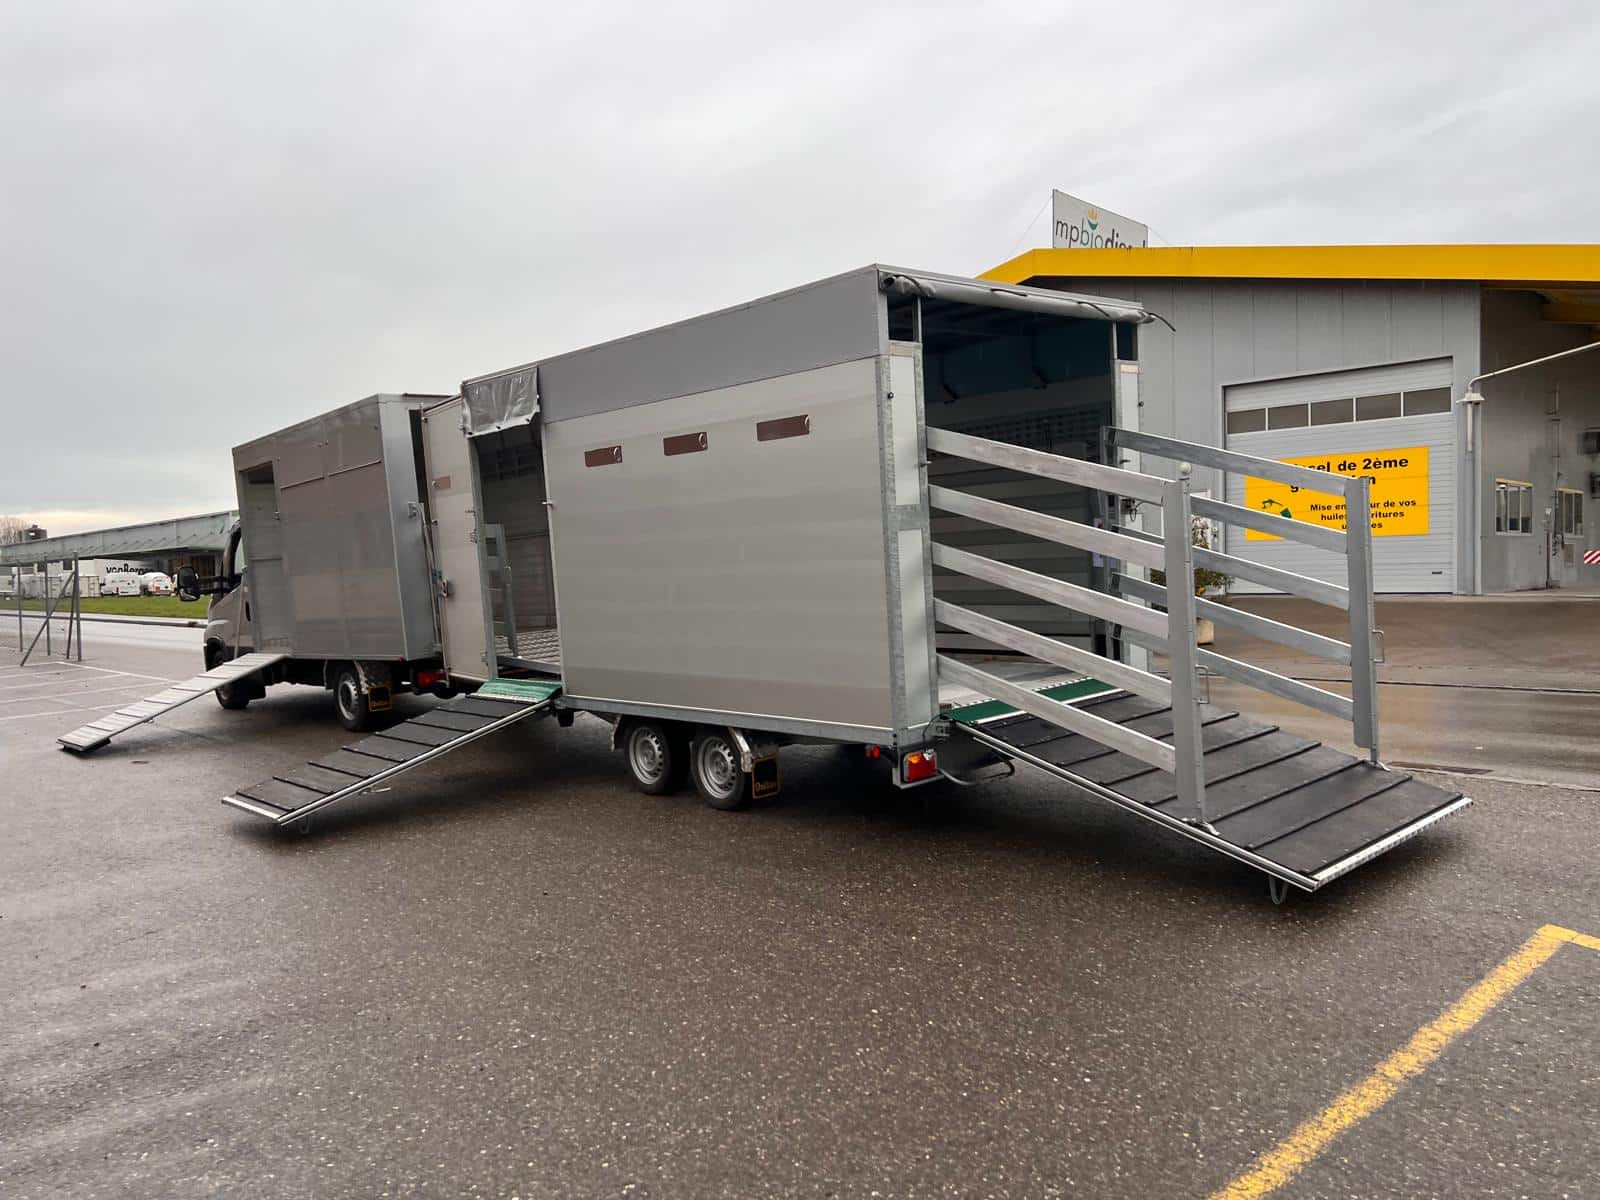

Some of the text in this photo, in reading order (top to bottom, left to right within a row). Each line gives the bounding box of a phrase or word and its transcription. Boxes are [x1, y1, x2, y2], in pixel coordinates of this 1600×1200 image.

[1337, 460, 1357, 472] de
[1362, 457, 1409, 470] 2ème
[1310, 503, 1332, 512] Mise
[1383, 499, 1396, 508] de
[1398, 499, 1417, 507] vos
[1370, 510, 1405, 519] ritures
